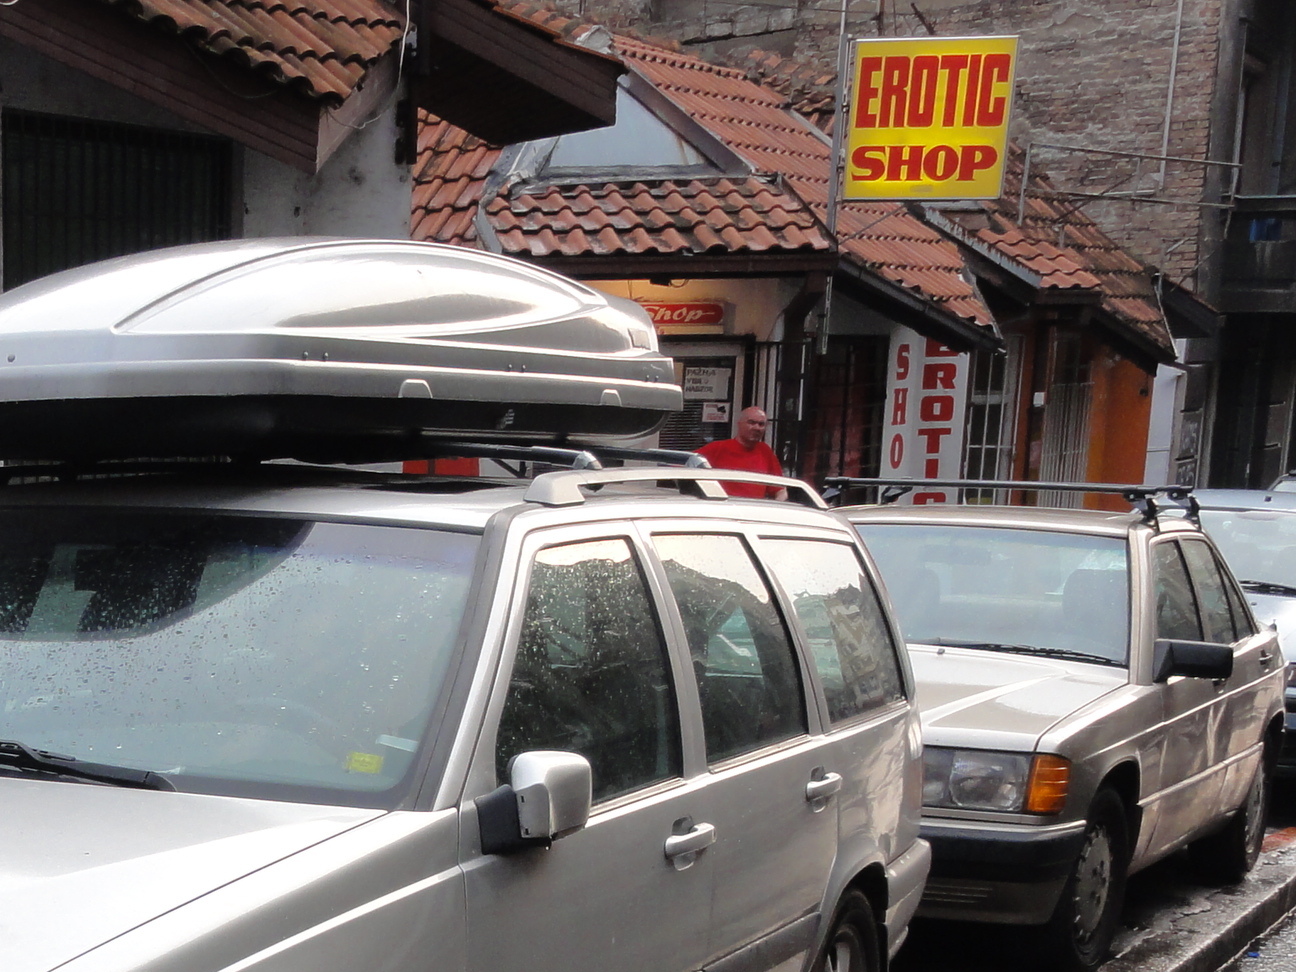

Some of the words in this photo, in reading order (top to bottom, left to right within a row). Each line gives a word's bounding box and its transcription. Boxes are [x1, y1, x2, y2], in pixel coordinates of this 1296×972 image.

[855, 54, 1011, 128] EROTIC
[851, 145, 998, 181] SHOP
[890, 344, 911, 470] SHO
